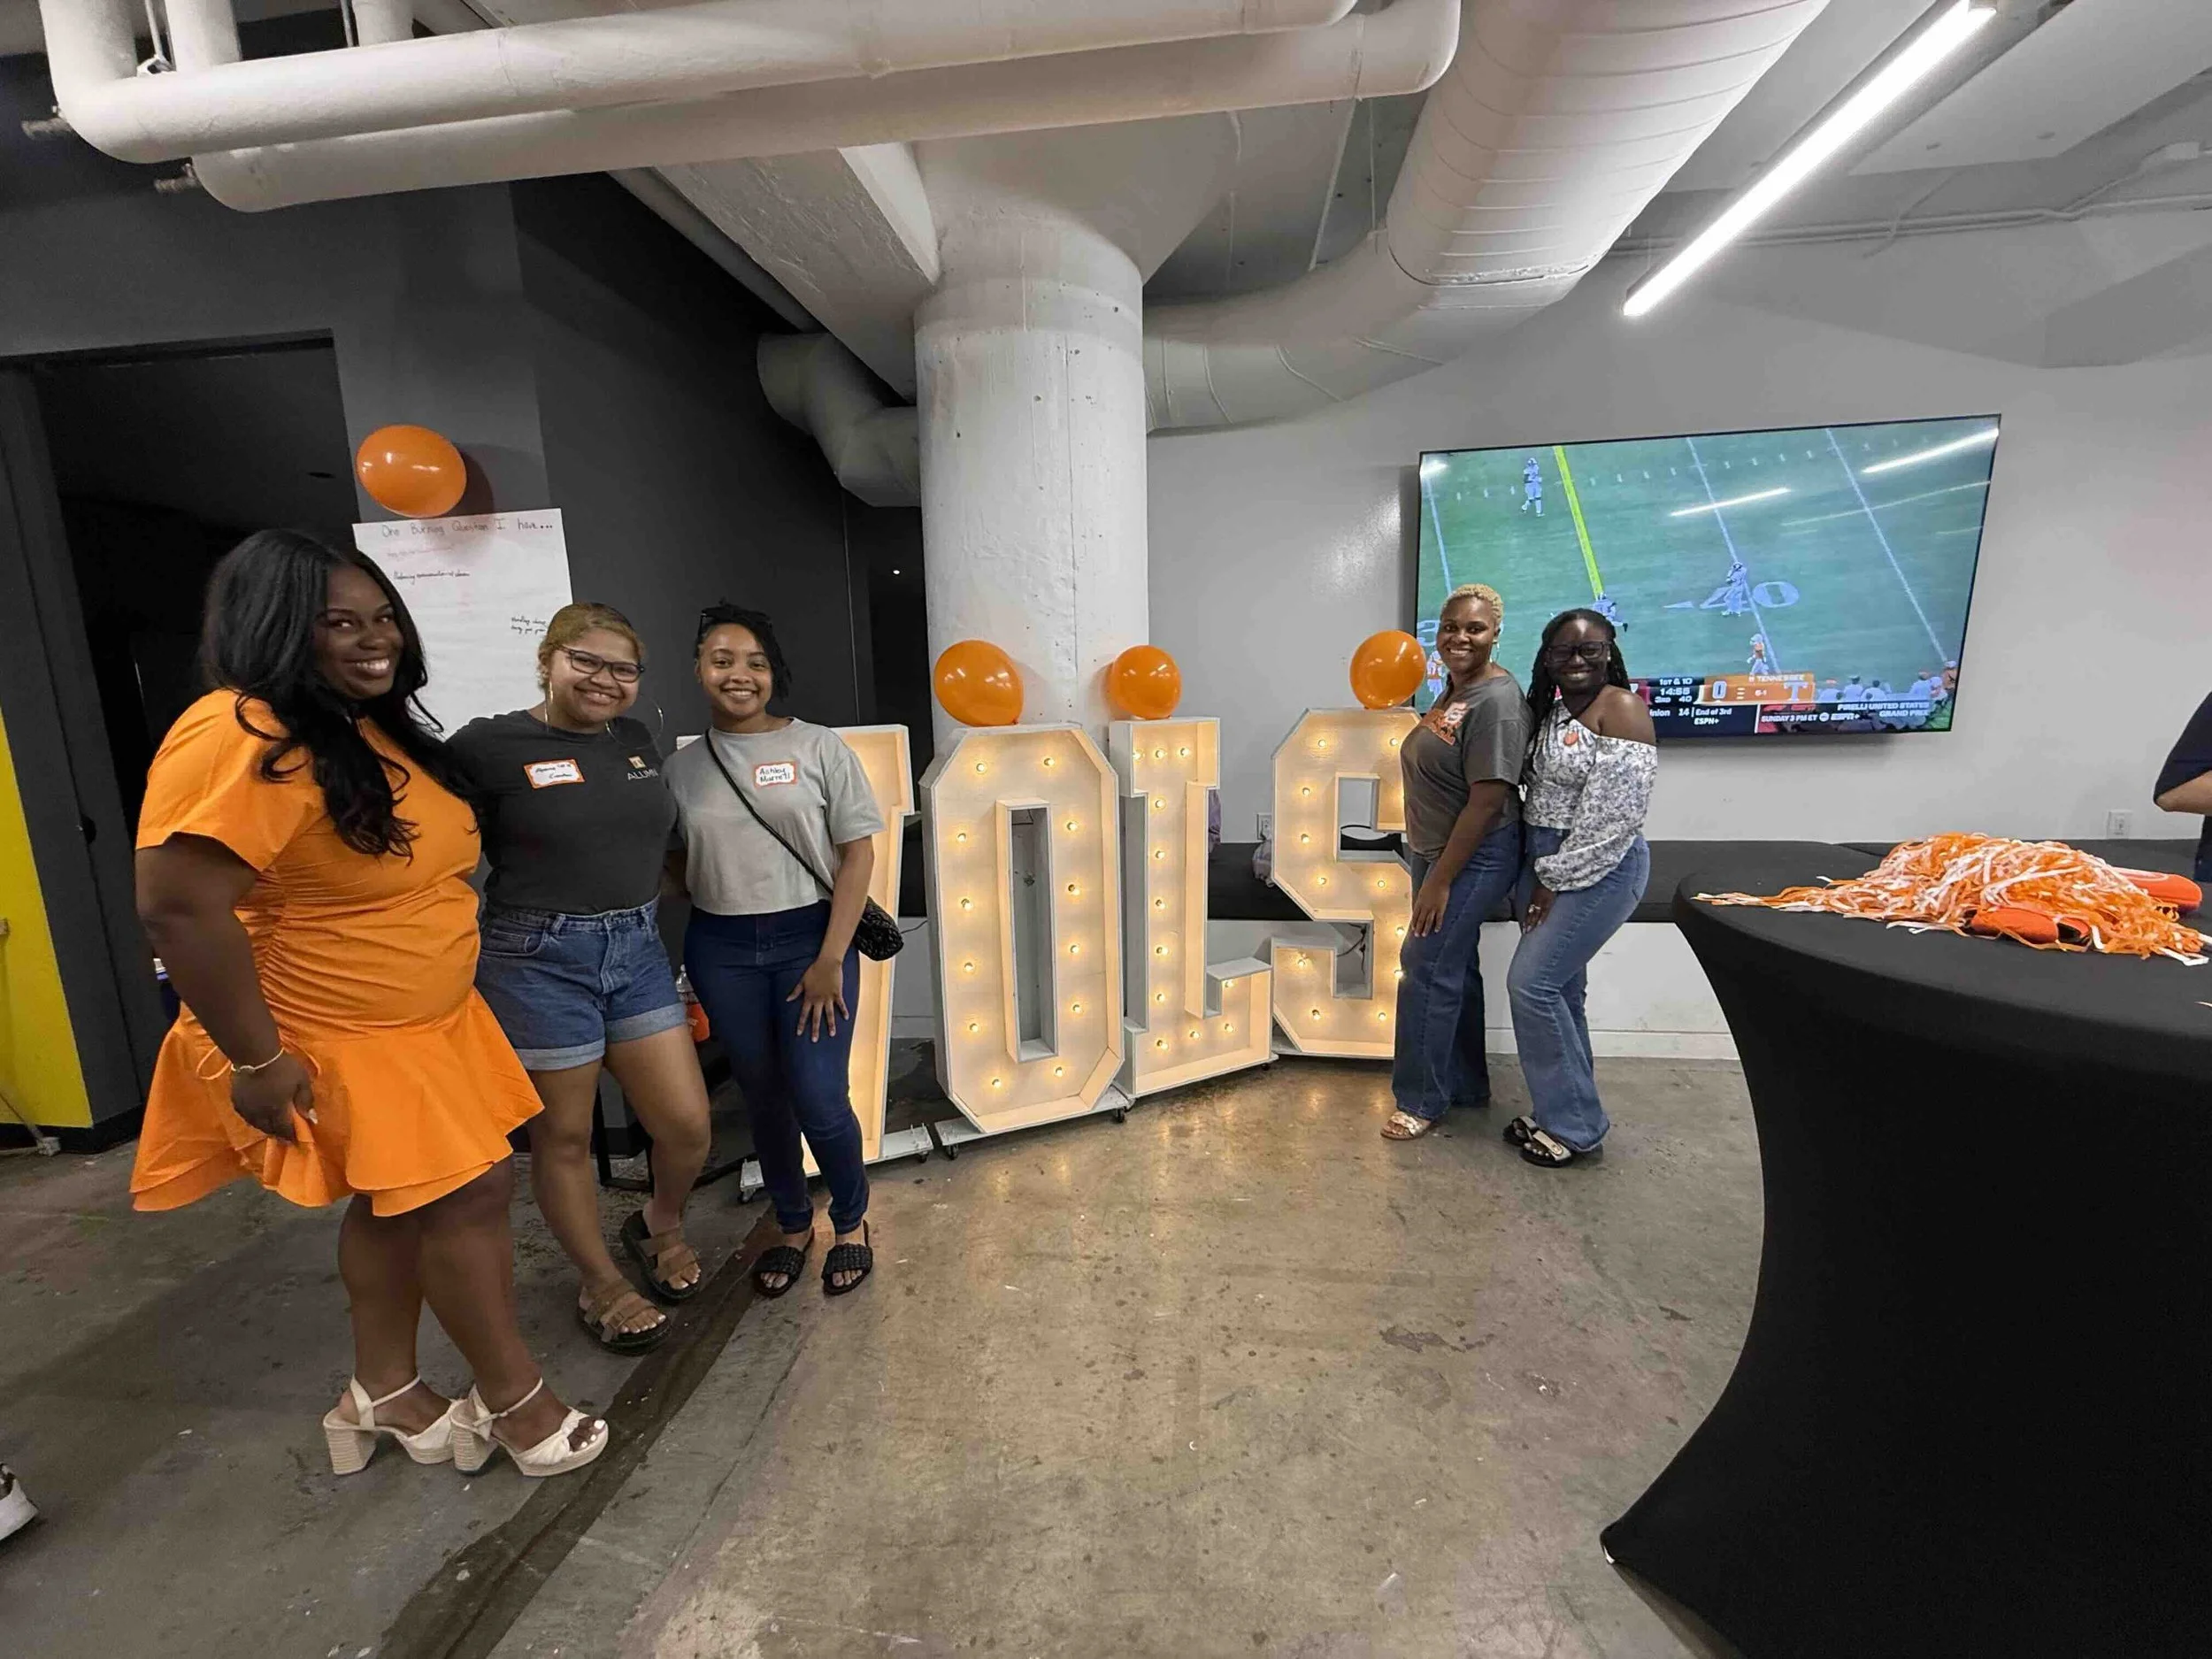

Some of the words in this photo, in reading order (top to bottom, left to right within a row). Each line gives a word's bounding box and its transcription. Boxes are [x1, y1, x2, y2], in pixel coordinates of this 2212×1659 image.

[382, 525, 399, 538] One
[451, 520, 488, 532] Question
[495, 518, 505, 530] I
